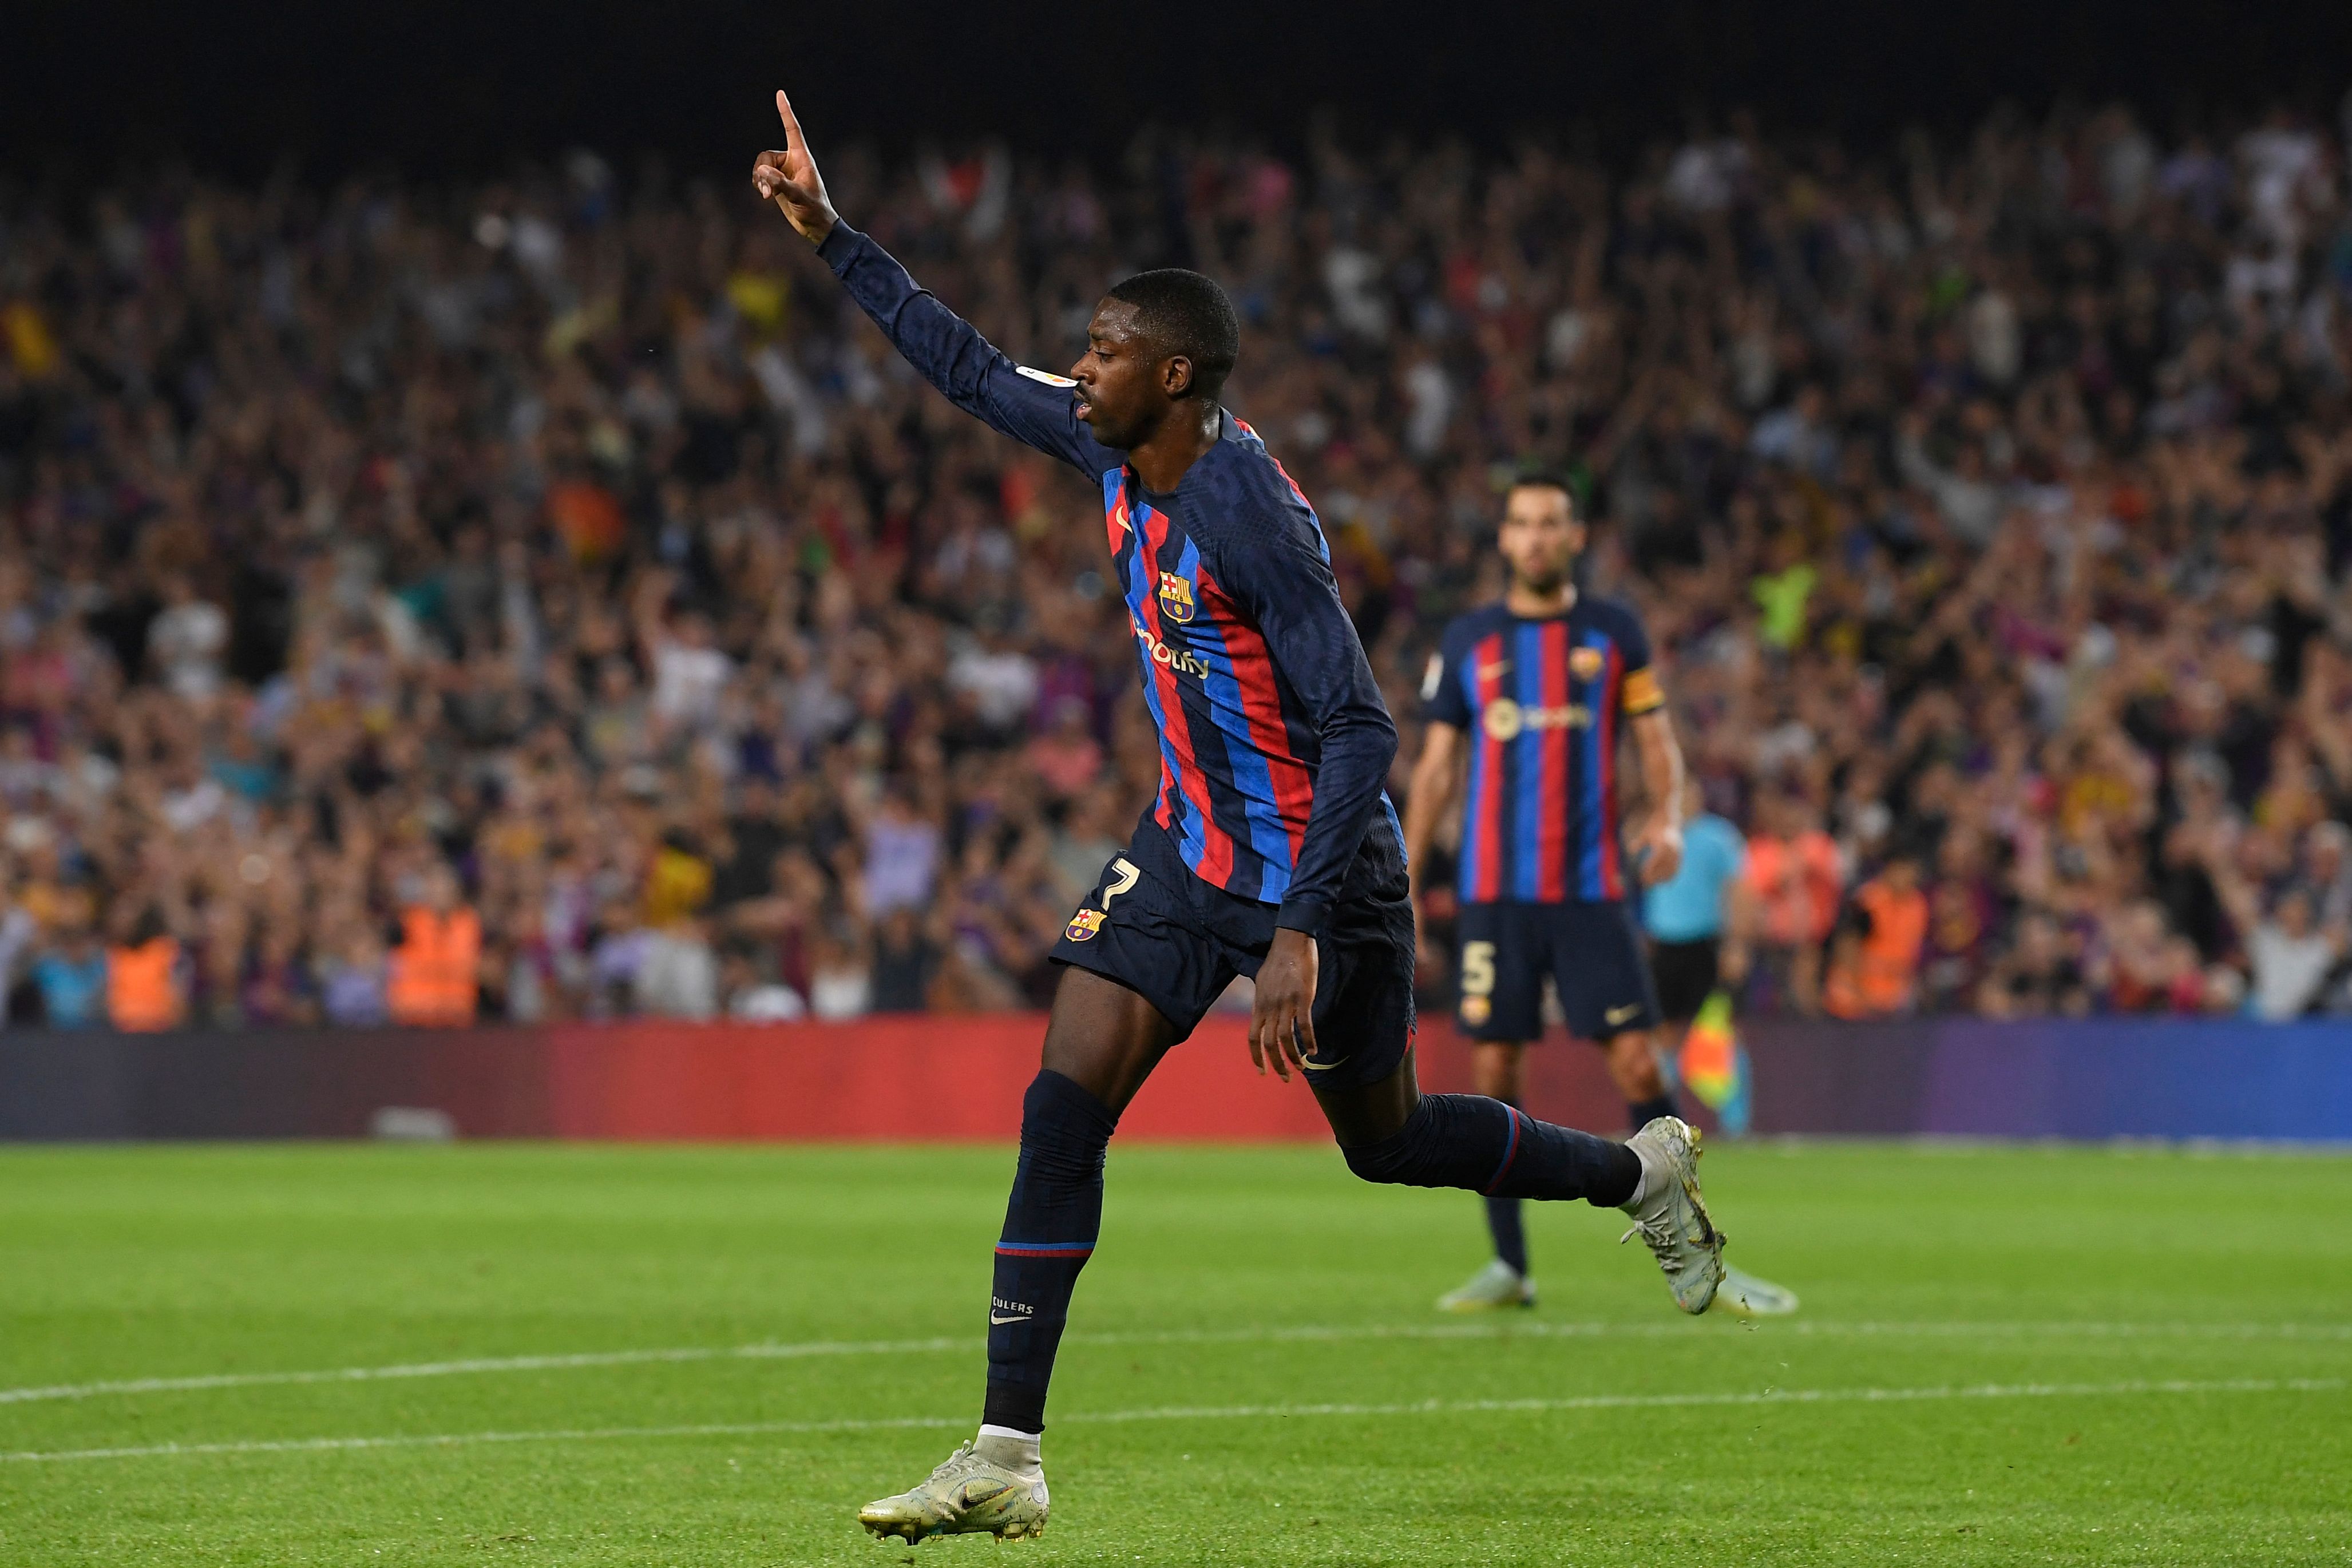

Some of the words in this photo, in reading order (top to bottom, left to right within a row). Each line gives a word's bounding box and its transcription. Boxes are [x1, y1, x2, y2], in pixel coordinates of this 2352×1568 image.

[1170, 592, 1184, 602] FCB
[1135, 616, 1209, 680] potify
[1100, 858, 1141, 912] 7
[1462, 940, 1496, 995] 5
[993, 1296, 1034, 1314] CULERS
